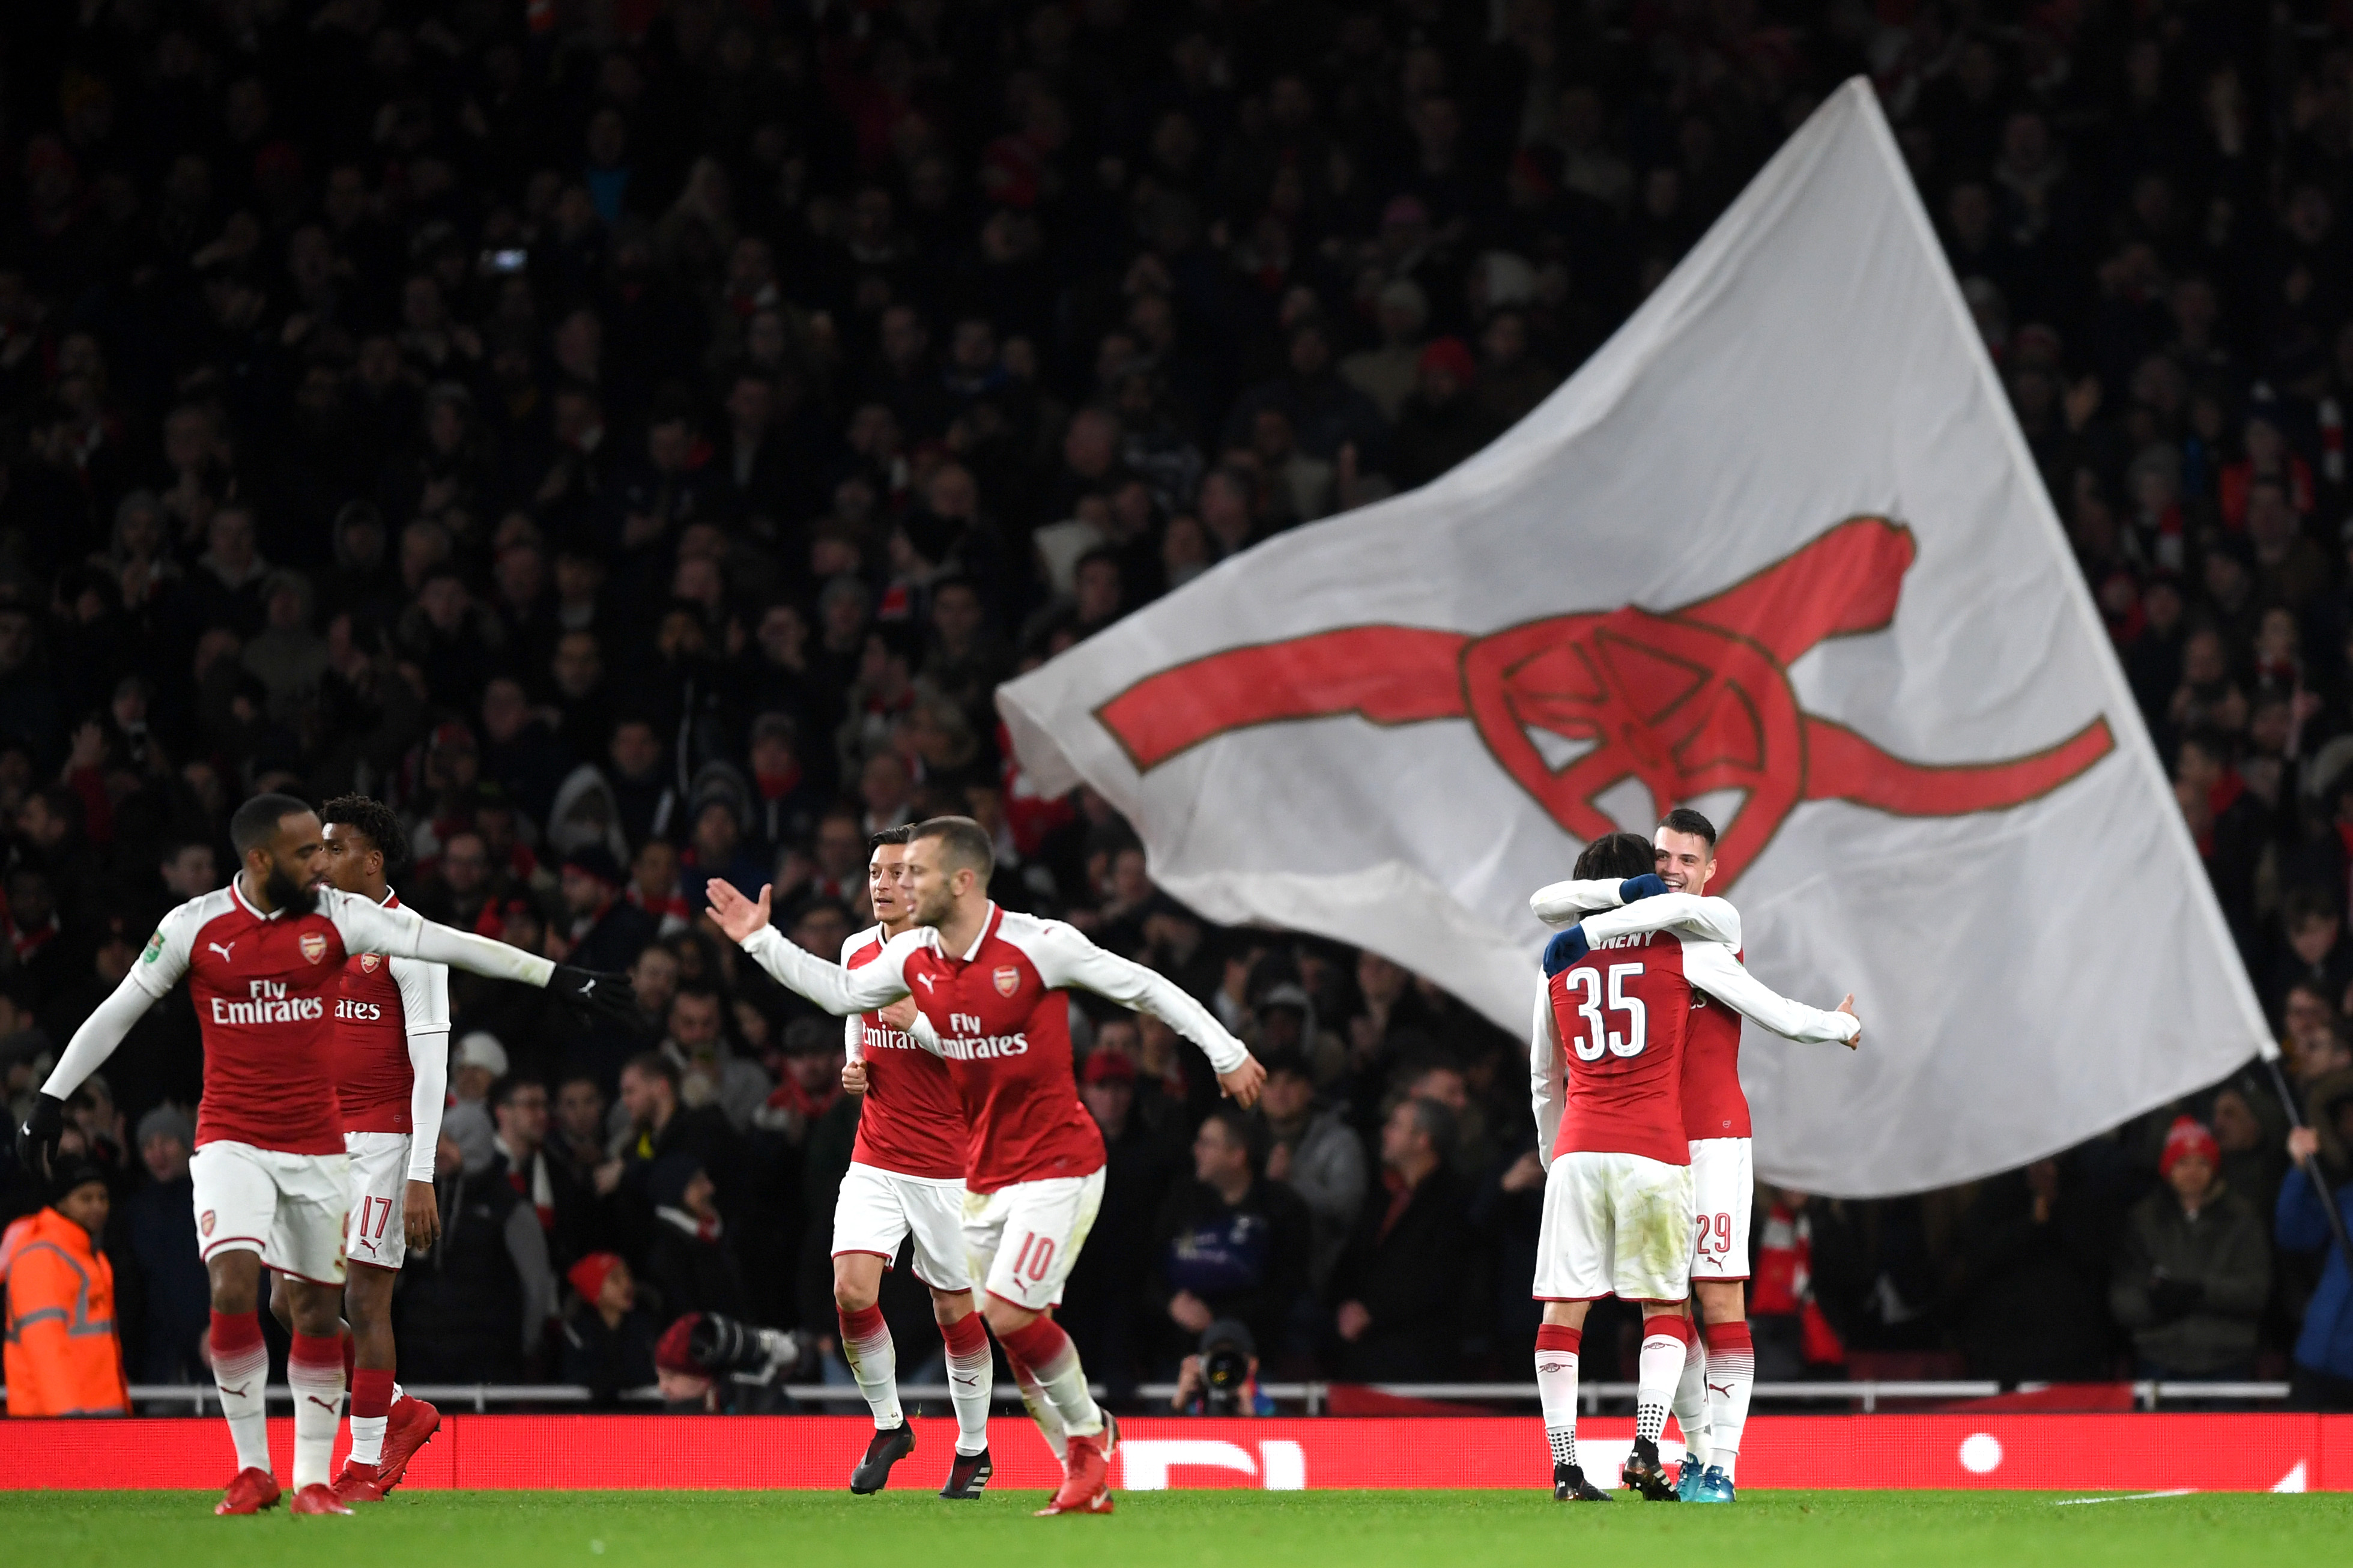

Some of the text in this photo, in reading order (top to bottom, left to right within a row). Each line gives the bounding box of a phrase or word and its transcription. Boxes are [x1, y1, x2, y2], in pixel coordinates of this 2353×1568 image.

[249, 979, 287, 1000] Fly
[211, 996, 324, 1025] Emirates
[334, 999, 381, 1020] ates
[949, 1013, 981, 1035] Fly
[1566, 962, 1647, 1061] 35
[360, 1196, 393, 1238] 17
[1697, 1212, 1731, 1254] 29
[1013, 1231, 1055, 1282] 10
